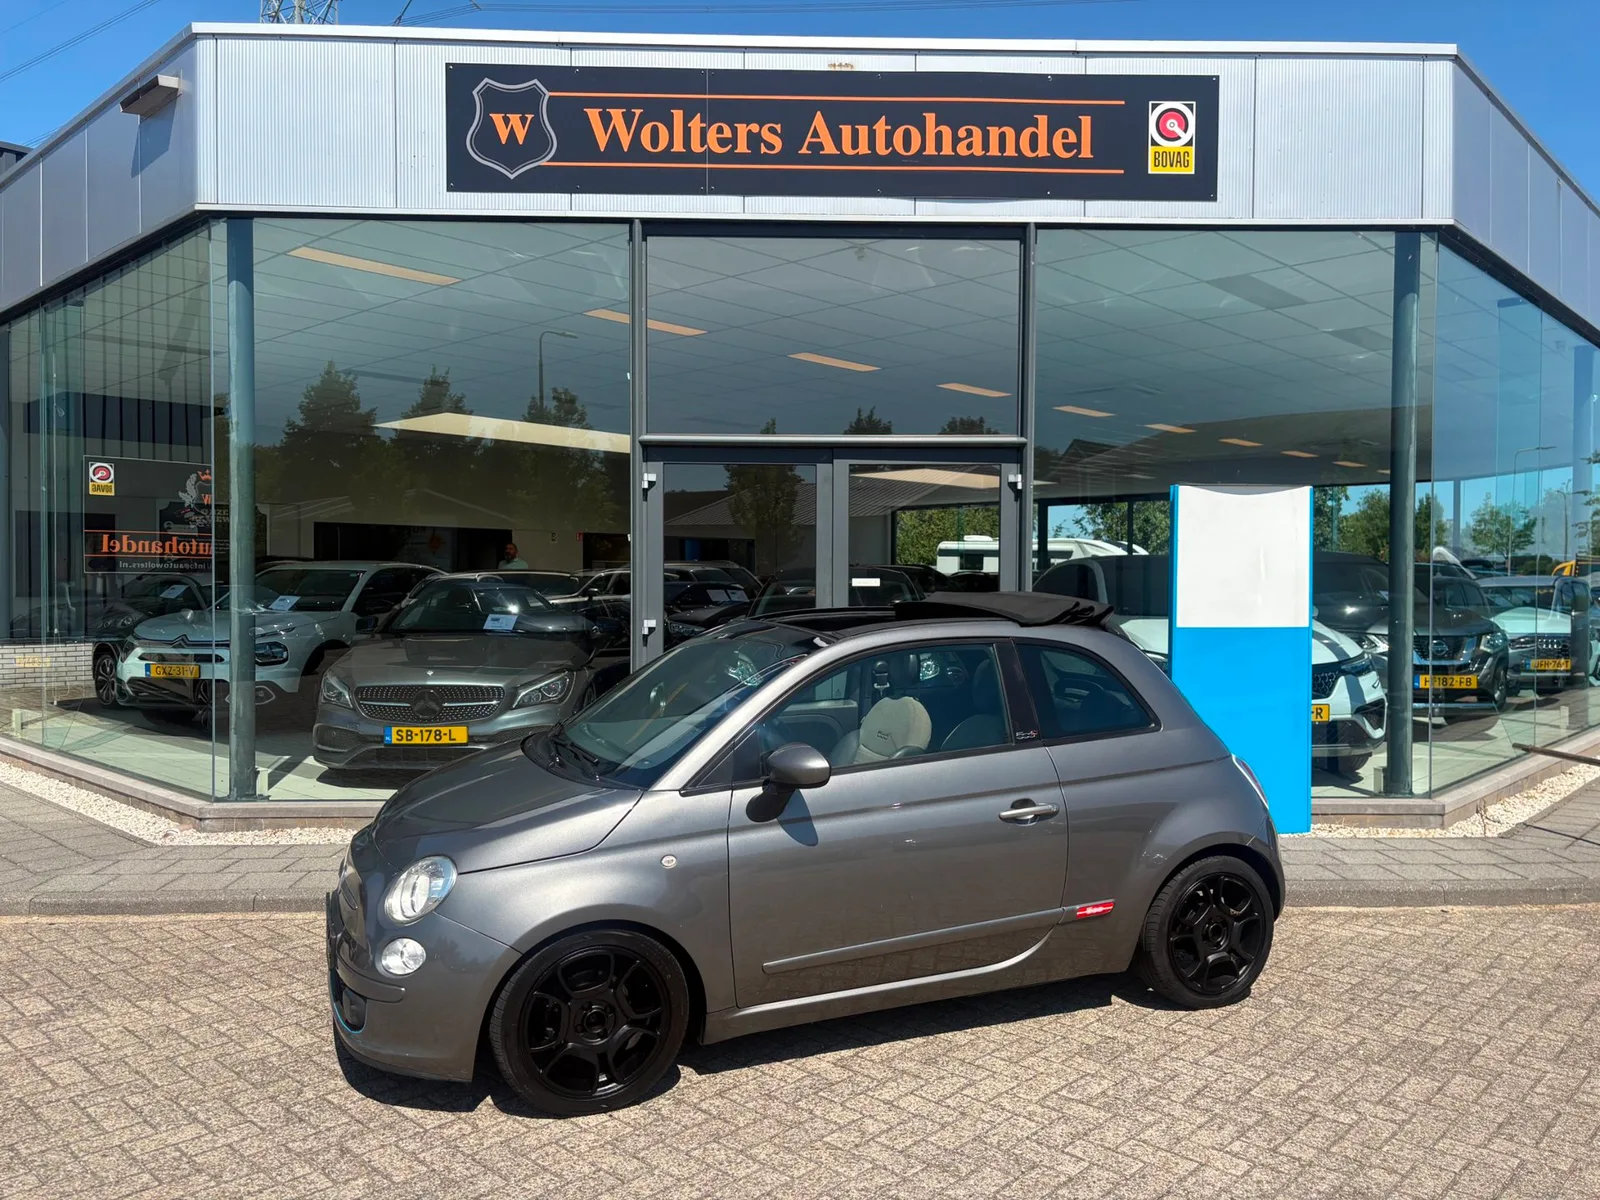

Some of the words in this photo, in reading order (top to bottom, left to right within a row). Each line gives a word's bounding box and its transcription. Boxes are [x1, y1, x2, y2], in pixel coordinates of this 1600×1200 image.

[489, 113, 534, 145] W
[583, 108, 784, 155] Wolters
[798, 111, 1094, 159] Autohandel
[1153, 151, 1191, 171] BOVAG
[155, 665, 195, 677] GXZ-31-V
[396, 728, 457, 743] SB-178-L
